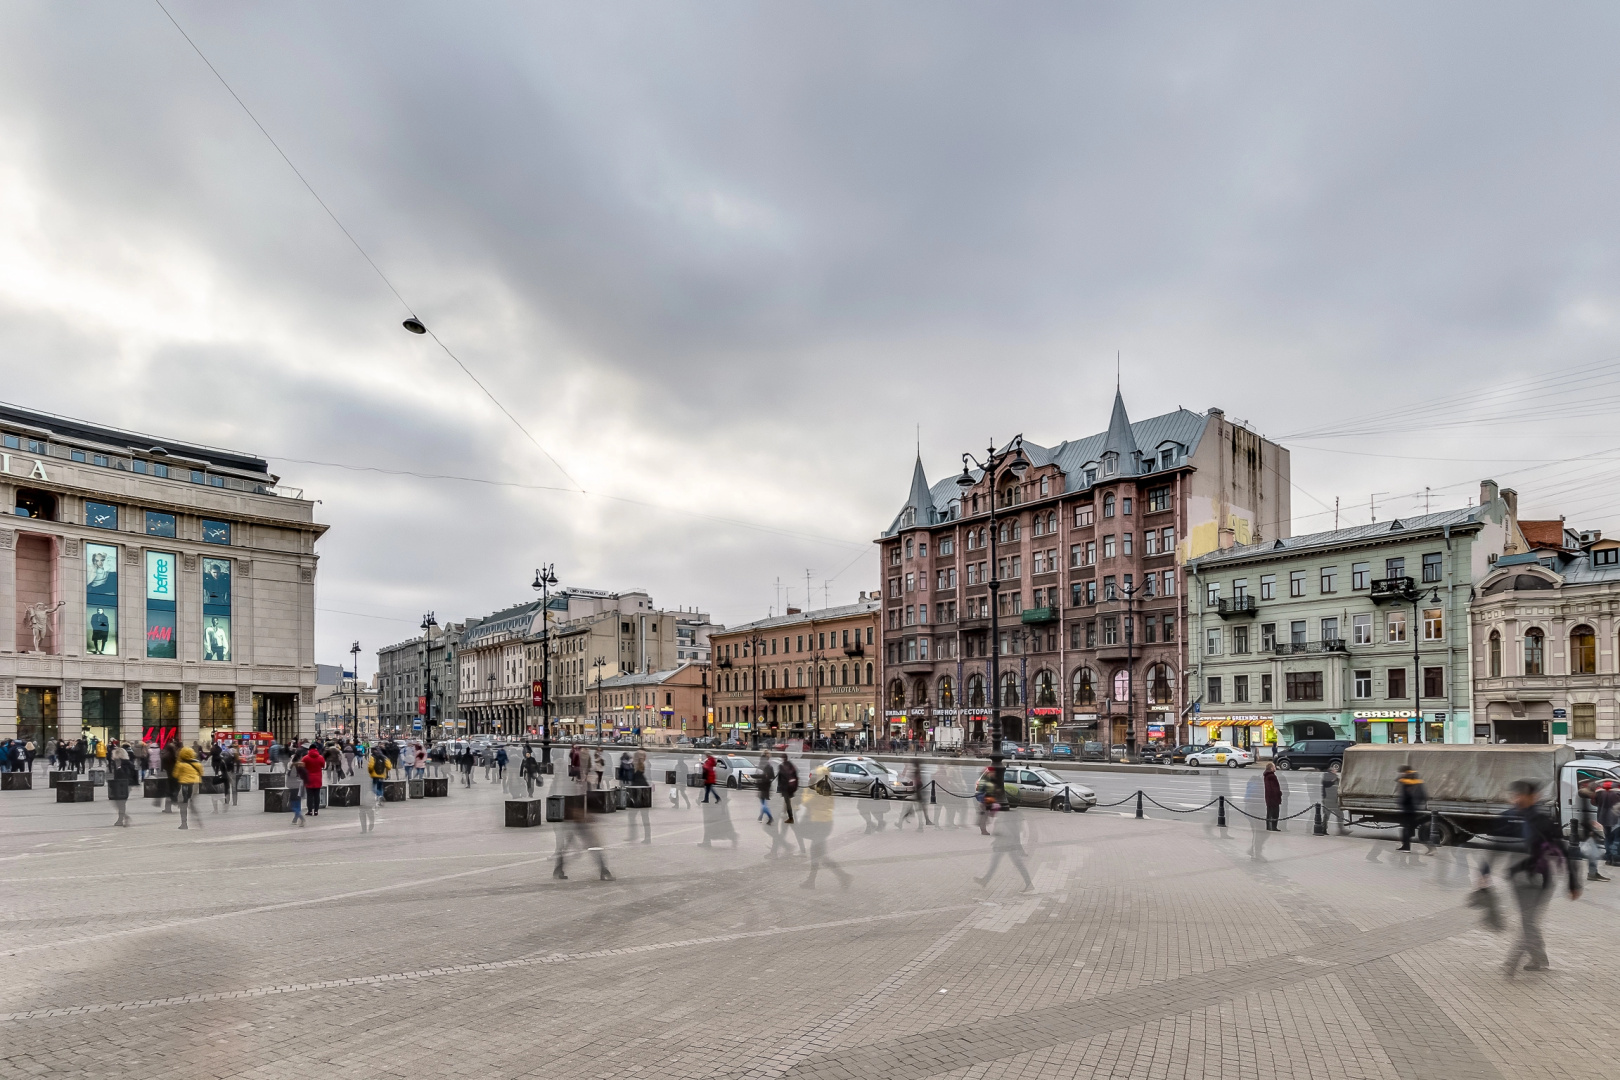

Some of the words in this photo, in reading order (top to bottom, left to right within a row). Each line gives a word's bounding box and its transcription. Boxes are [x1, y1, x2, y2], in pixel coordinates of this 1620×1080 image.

[153, 559, 168, 594] befree
[147, 625, 172, 641] H&M
[142, 727, 177, 750] HM
